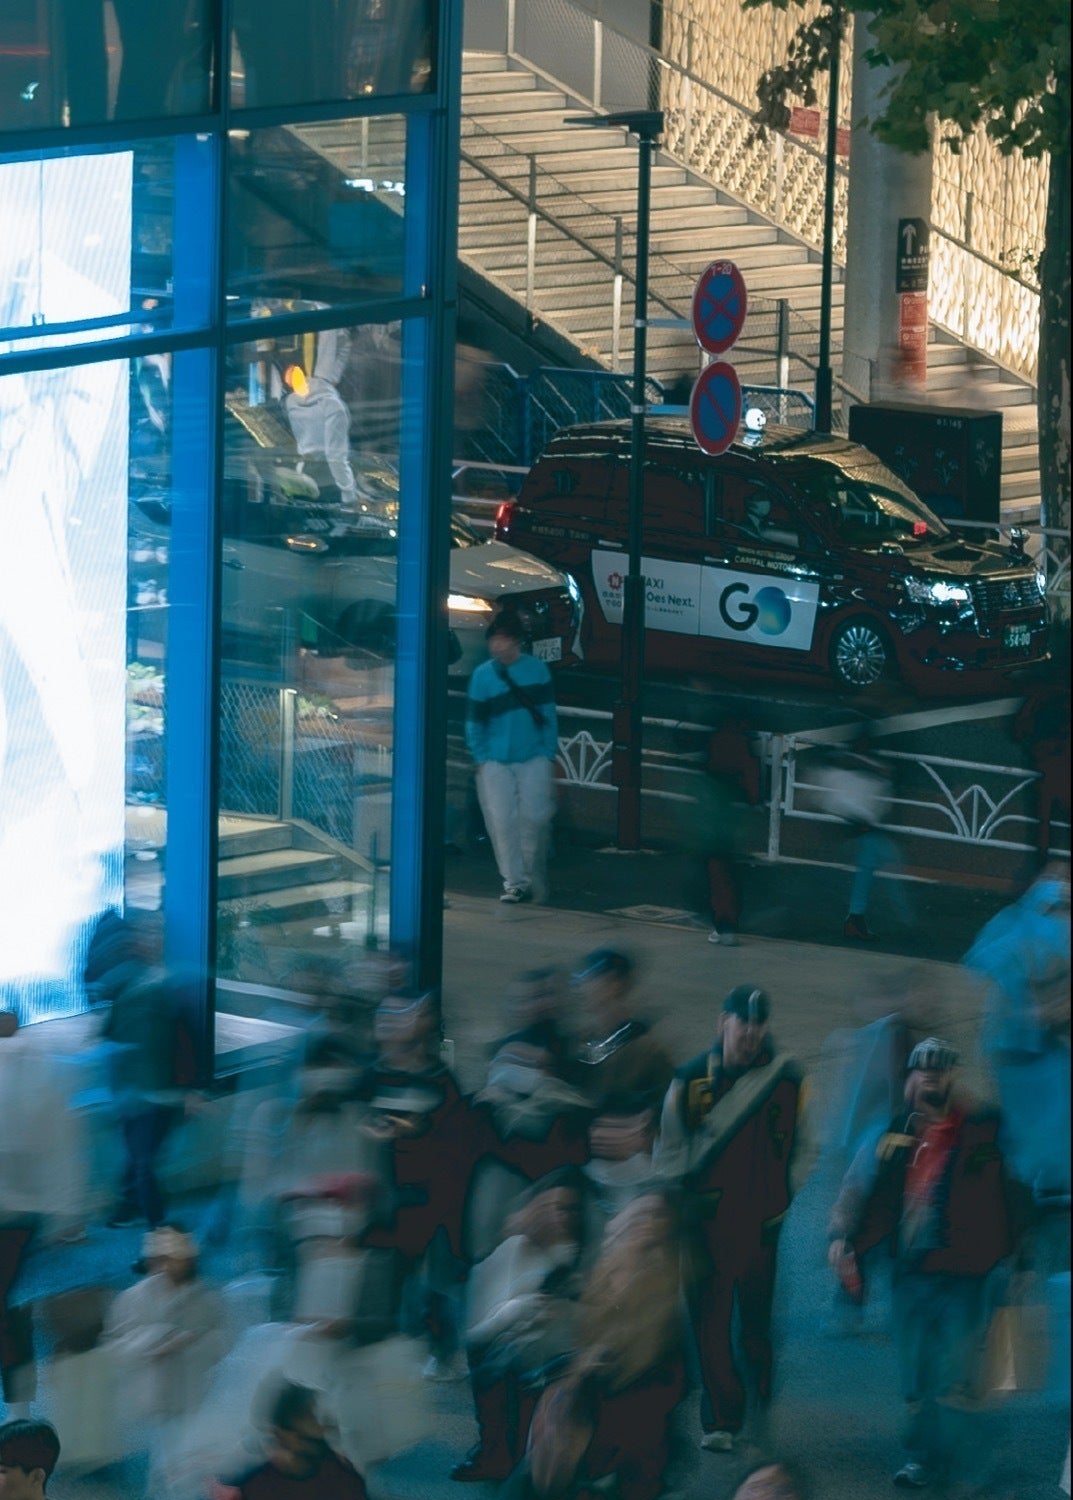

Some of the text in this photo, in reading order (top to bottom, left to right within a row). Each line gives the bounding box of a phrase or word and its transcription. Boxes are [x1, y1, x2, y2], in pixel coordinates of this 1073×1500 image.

[646, 577, 664, 590] AXI
[646, 591, 695, 608] Oes Next.
